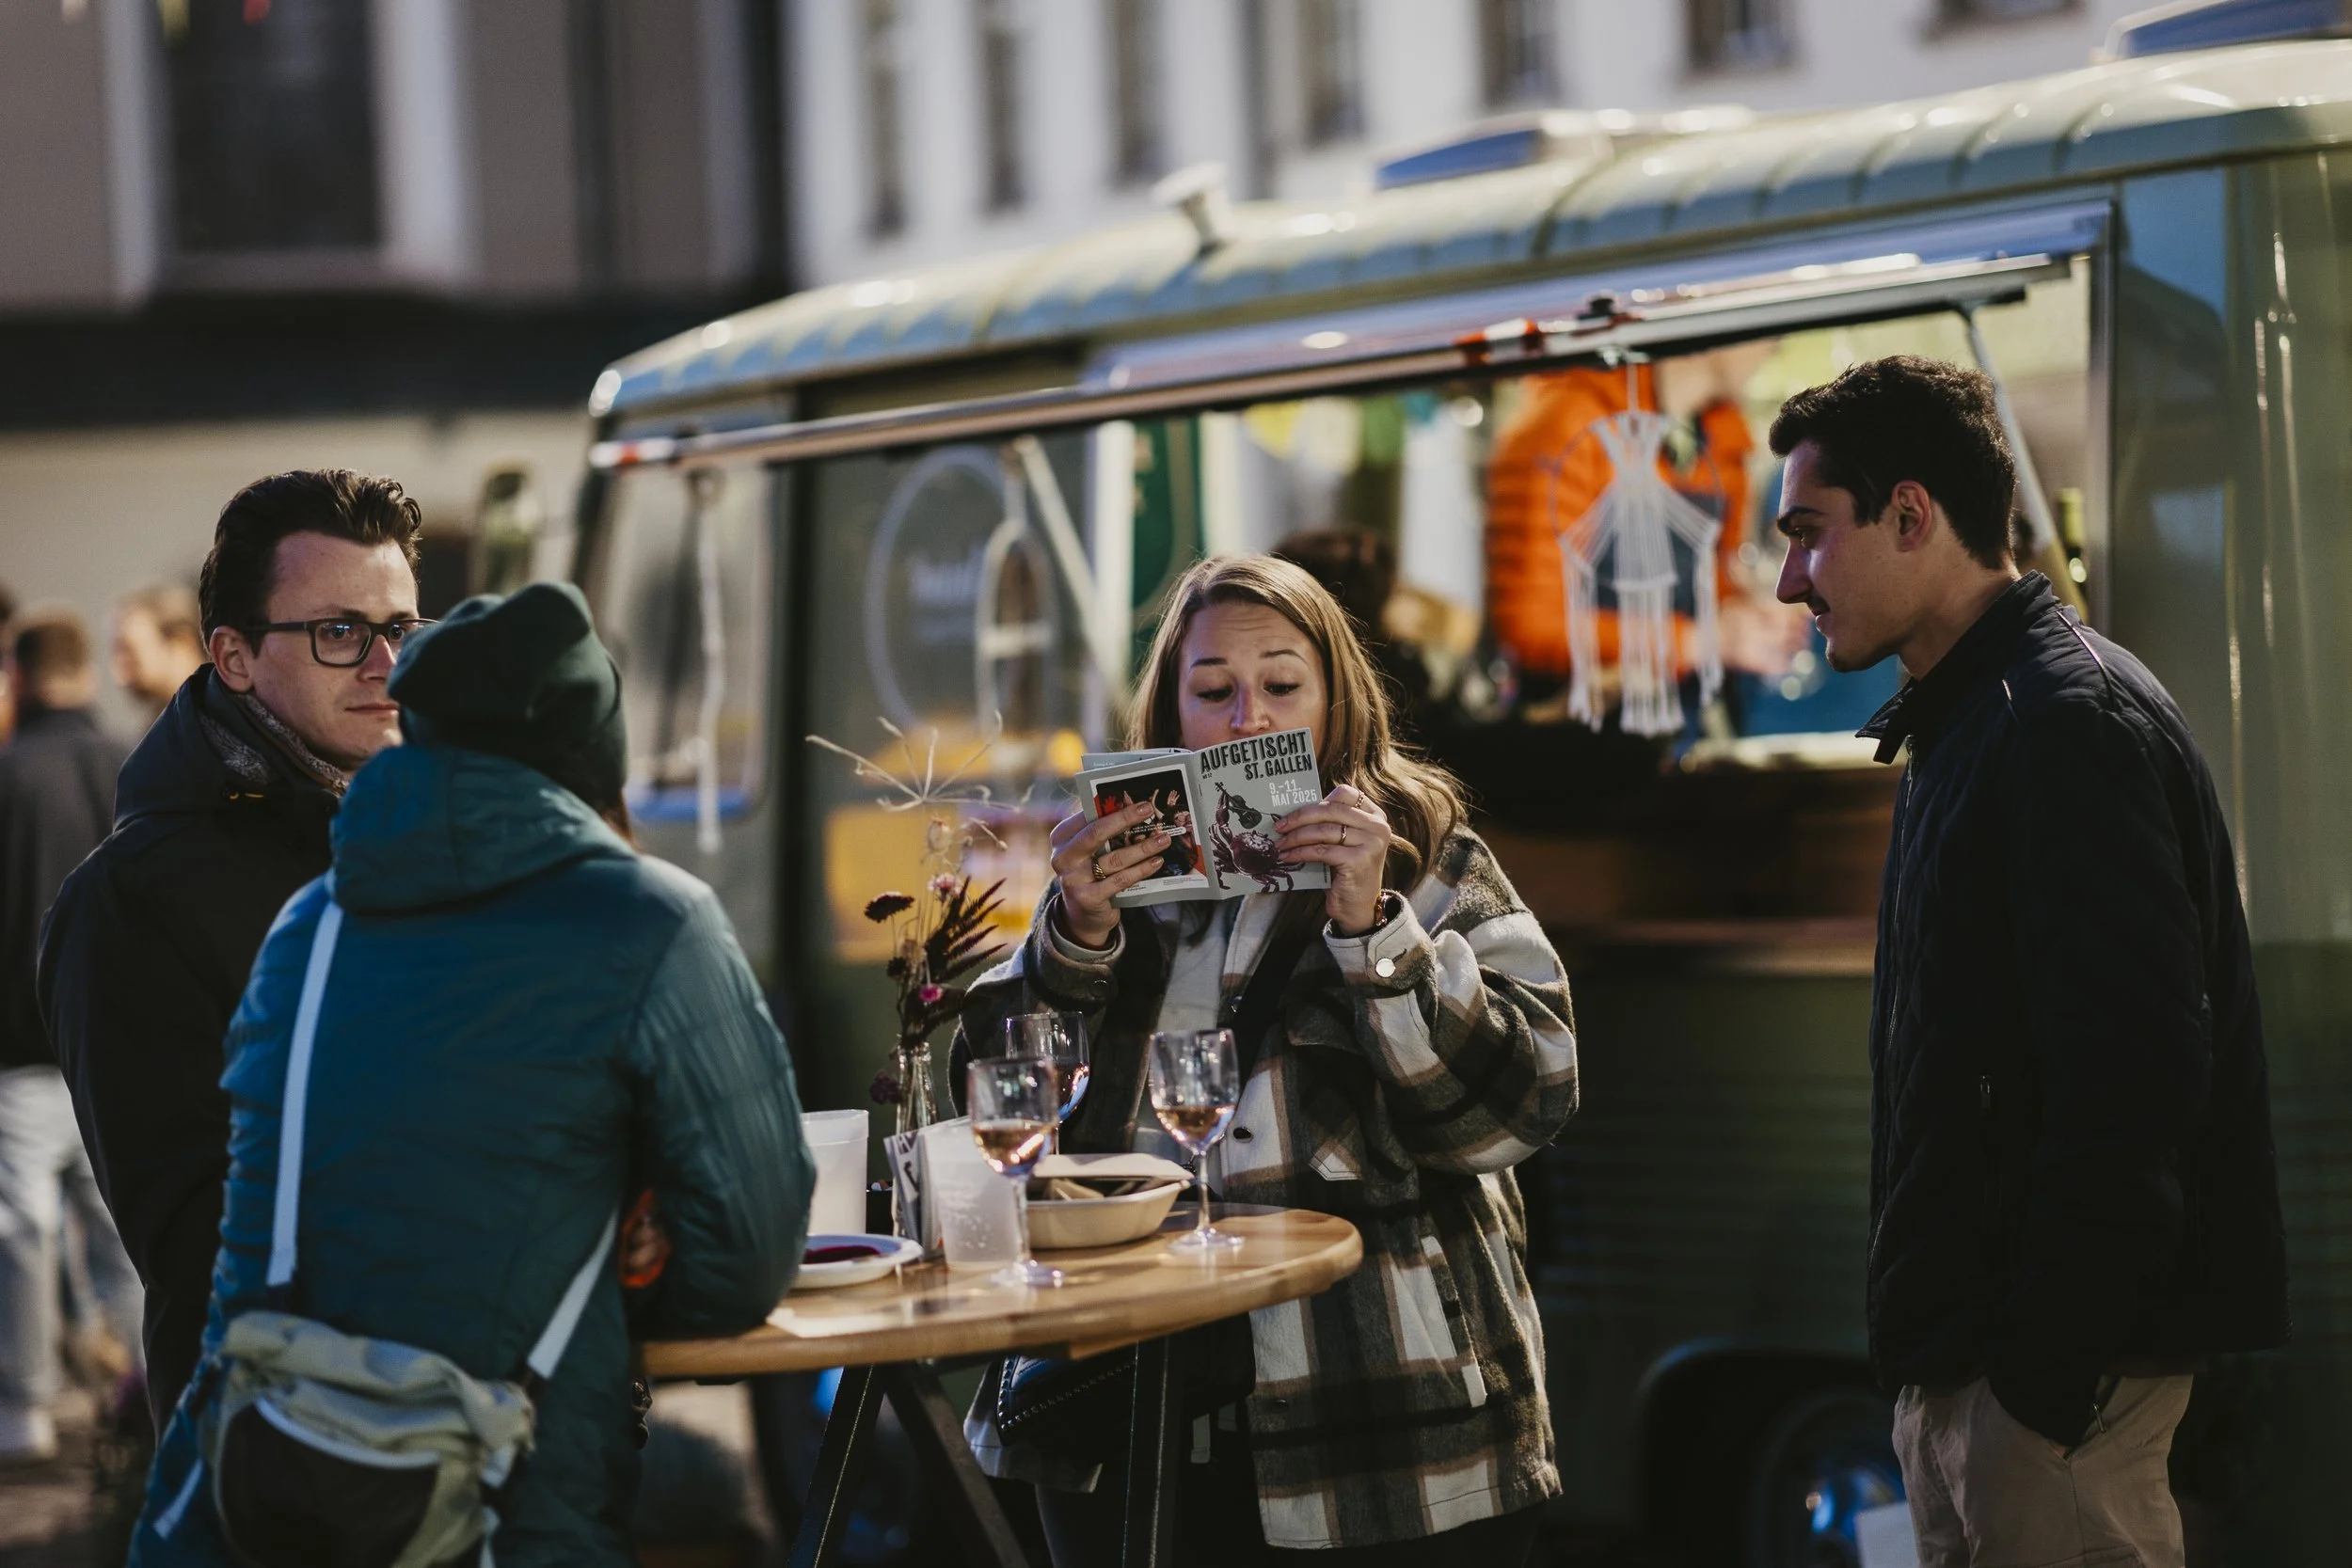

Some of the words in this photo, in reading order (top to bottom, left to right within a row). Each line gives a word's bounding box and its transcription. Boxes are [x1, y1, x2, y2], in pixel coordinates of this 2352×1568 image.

[1200, 732, 1307, 773] AUFGETISCHT
[1244, 762, 1264, 781] ST.
[1264, 753, 1312, 777] GALLEN
[1271, 792, 1290, 807] MAI
[1292, 788, 1318, 804] 2025
